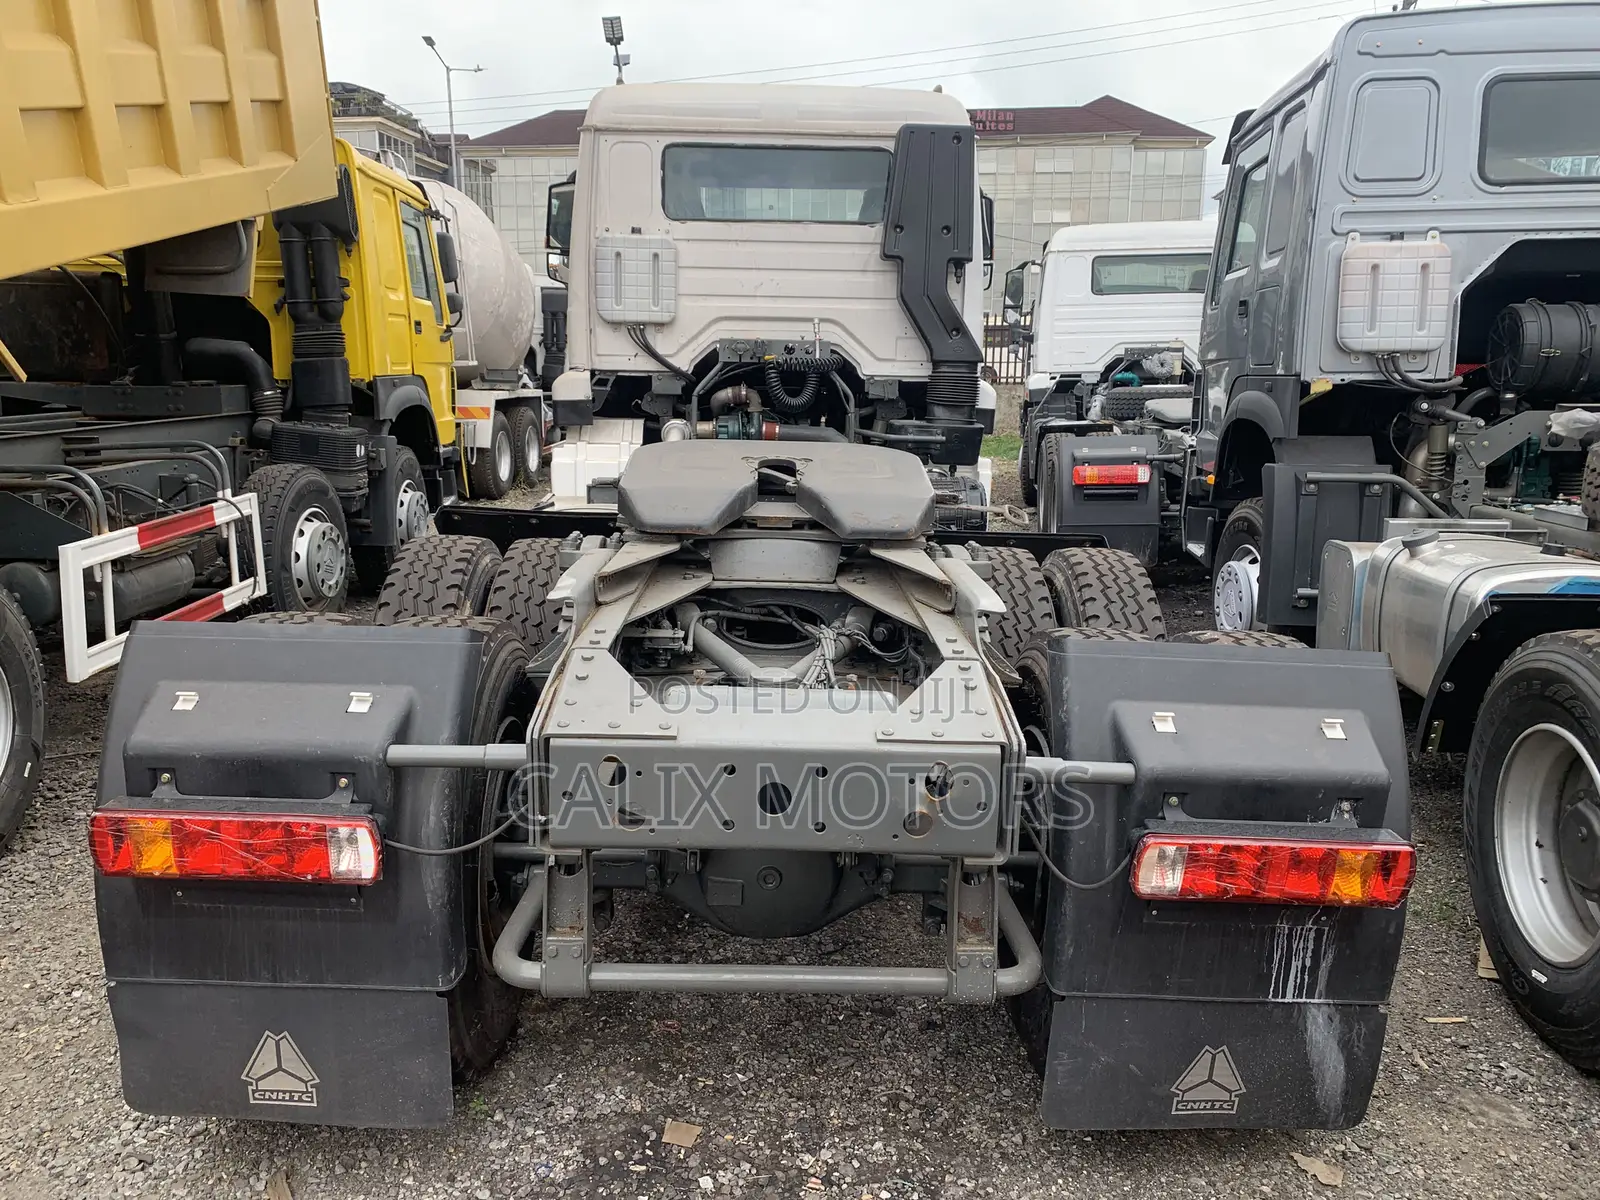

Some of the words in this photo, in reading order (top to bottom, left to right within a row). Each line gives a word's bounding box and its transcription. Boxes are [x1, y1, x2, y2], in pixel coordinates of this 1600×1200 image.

[976, 110, 1014, 121] Milan
[253, 1091, 313, 1102] CNHTC
[1176, 1101, 1234, 1110] CNHTC
